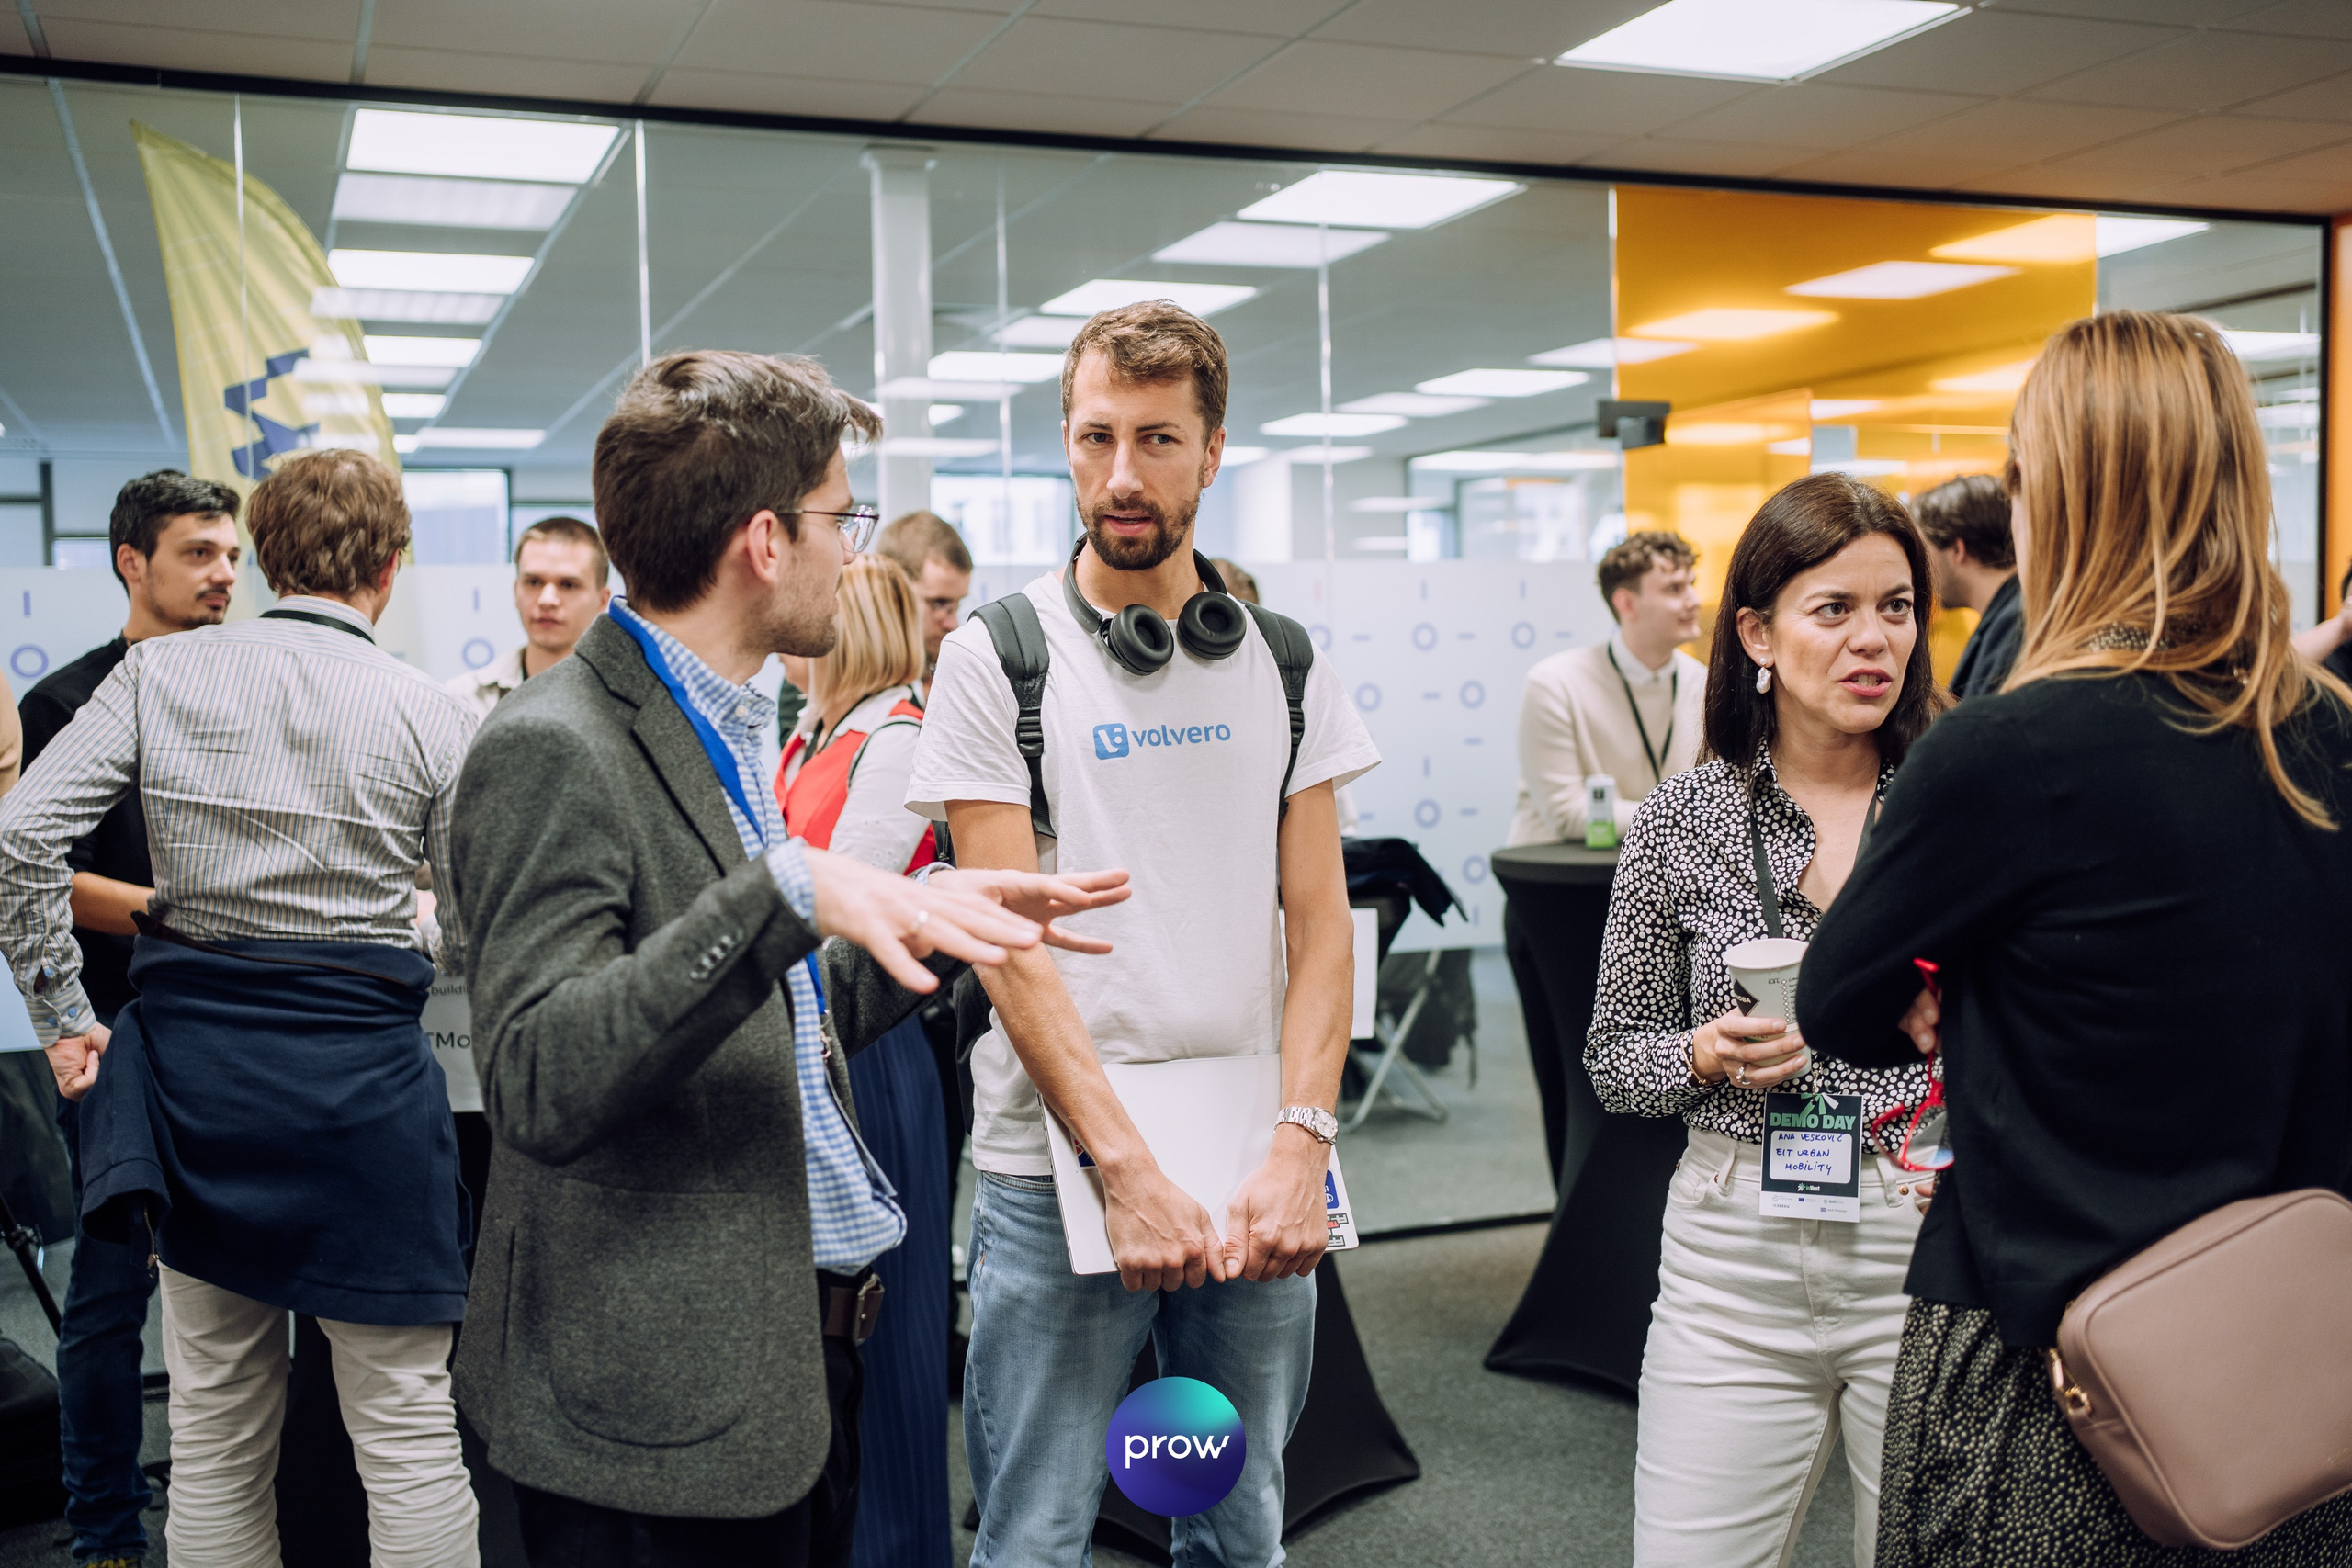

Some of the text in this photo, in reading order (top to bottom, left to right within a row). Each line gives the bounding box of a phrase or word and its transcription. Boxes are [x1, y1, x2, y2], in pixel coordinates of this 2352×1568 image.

[1131, 724, 1231, 747] volvero
[431, 984, 469, 997] buildi
[1770, 1112, 1856, 1131] DEMO DAY
[1779, 1133, 1795, 1141] ANA
[1776, 1148, 1830, 1157] EIT URBAN
